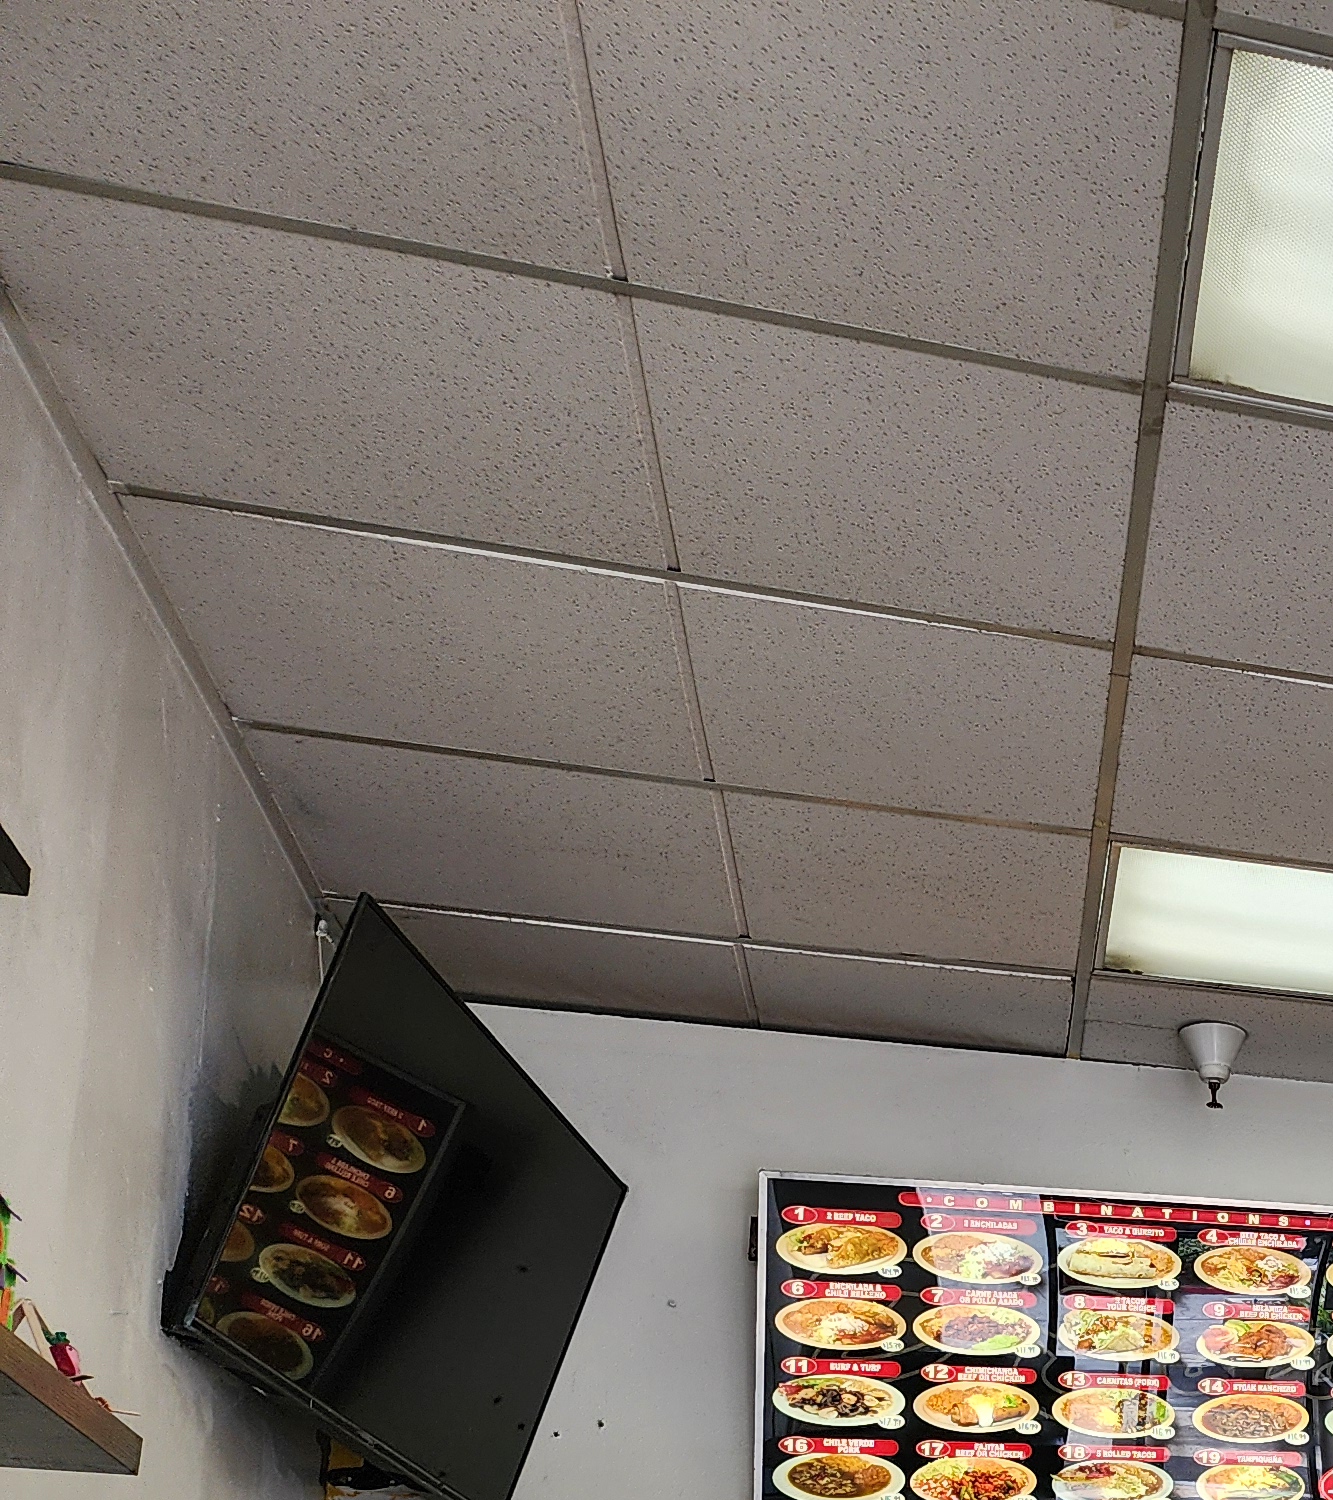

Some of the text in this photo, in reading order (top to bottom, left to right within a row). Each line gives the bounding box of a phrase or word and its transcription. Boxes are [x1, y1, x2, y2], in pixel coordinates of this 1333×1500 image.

[794, 1207, 805, 1221] 1
[855, 1214, 877, 1223] TACO
[930, 1215, 943, 1228] 2
[1076, 1222, 1088, 1235] 3
[1104, 1226, 1124, 1235] TACO
[1205, 1230, 1218, 1242] 4
[1258, 1233, 1278, 1241] TACO
[791, 1282, 804, 1295] 6
[931, 1290, 944, 1303] 7
[1074, 1296, 1086, 1308] 8
[1214, 1304, 1225, 1316] 9
[785, 1359, 809, 1372] 11
[925, 1366, 949, 1379] 12
[1063, 1373, 1085, 1386] 13
[1201, 1380, 1224, 1392] 14
[784, 1439, 808, 1452] 16
[922, 1443, 942, 1456] 17
[1063, 1447, 1085, 1459] 18
[1199, 1451, 1221, 1464] 19
